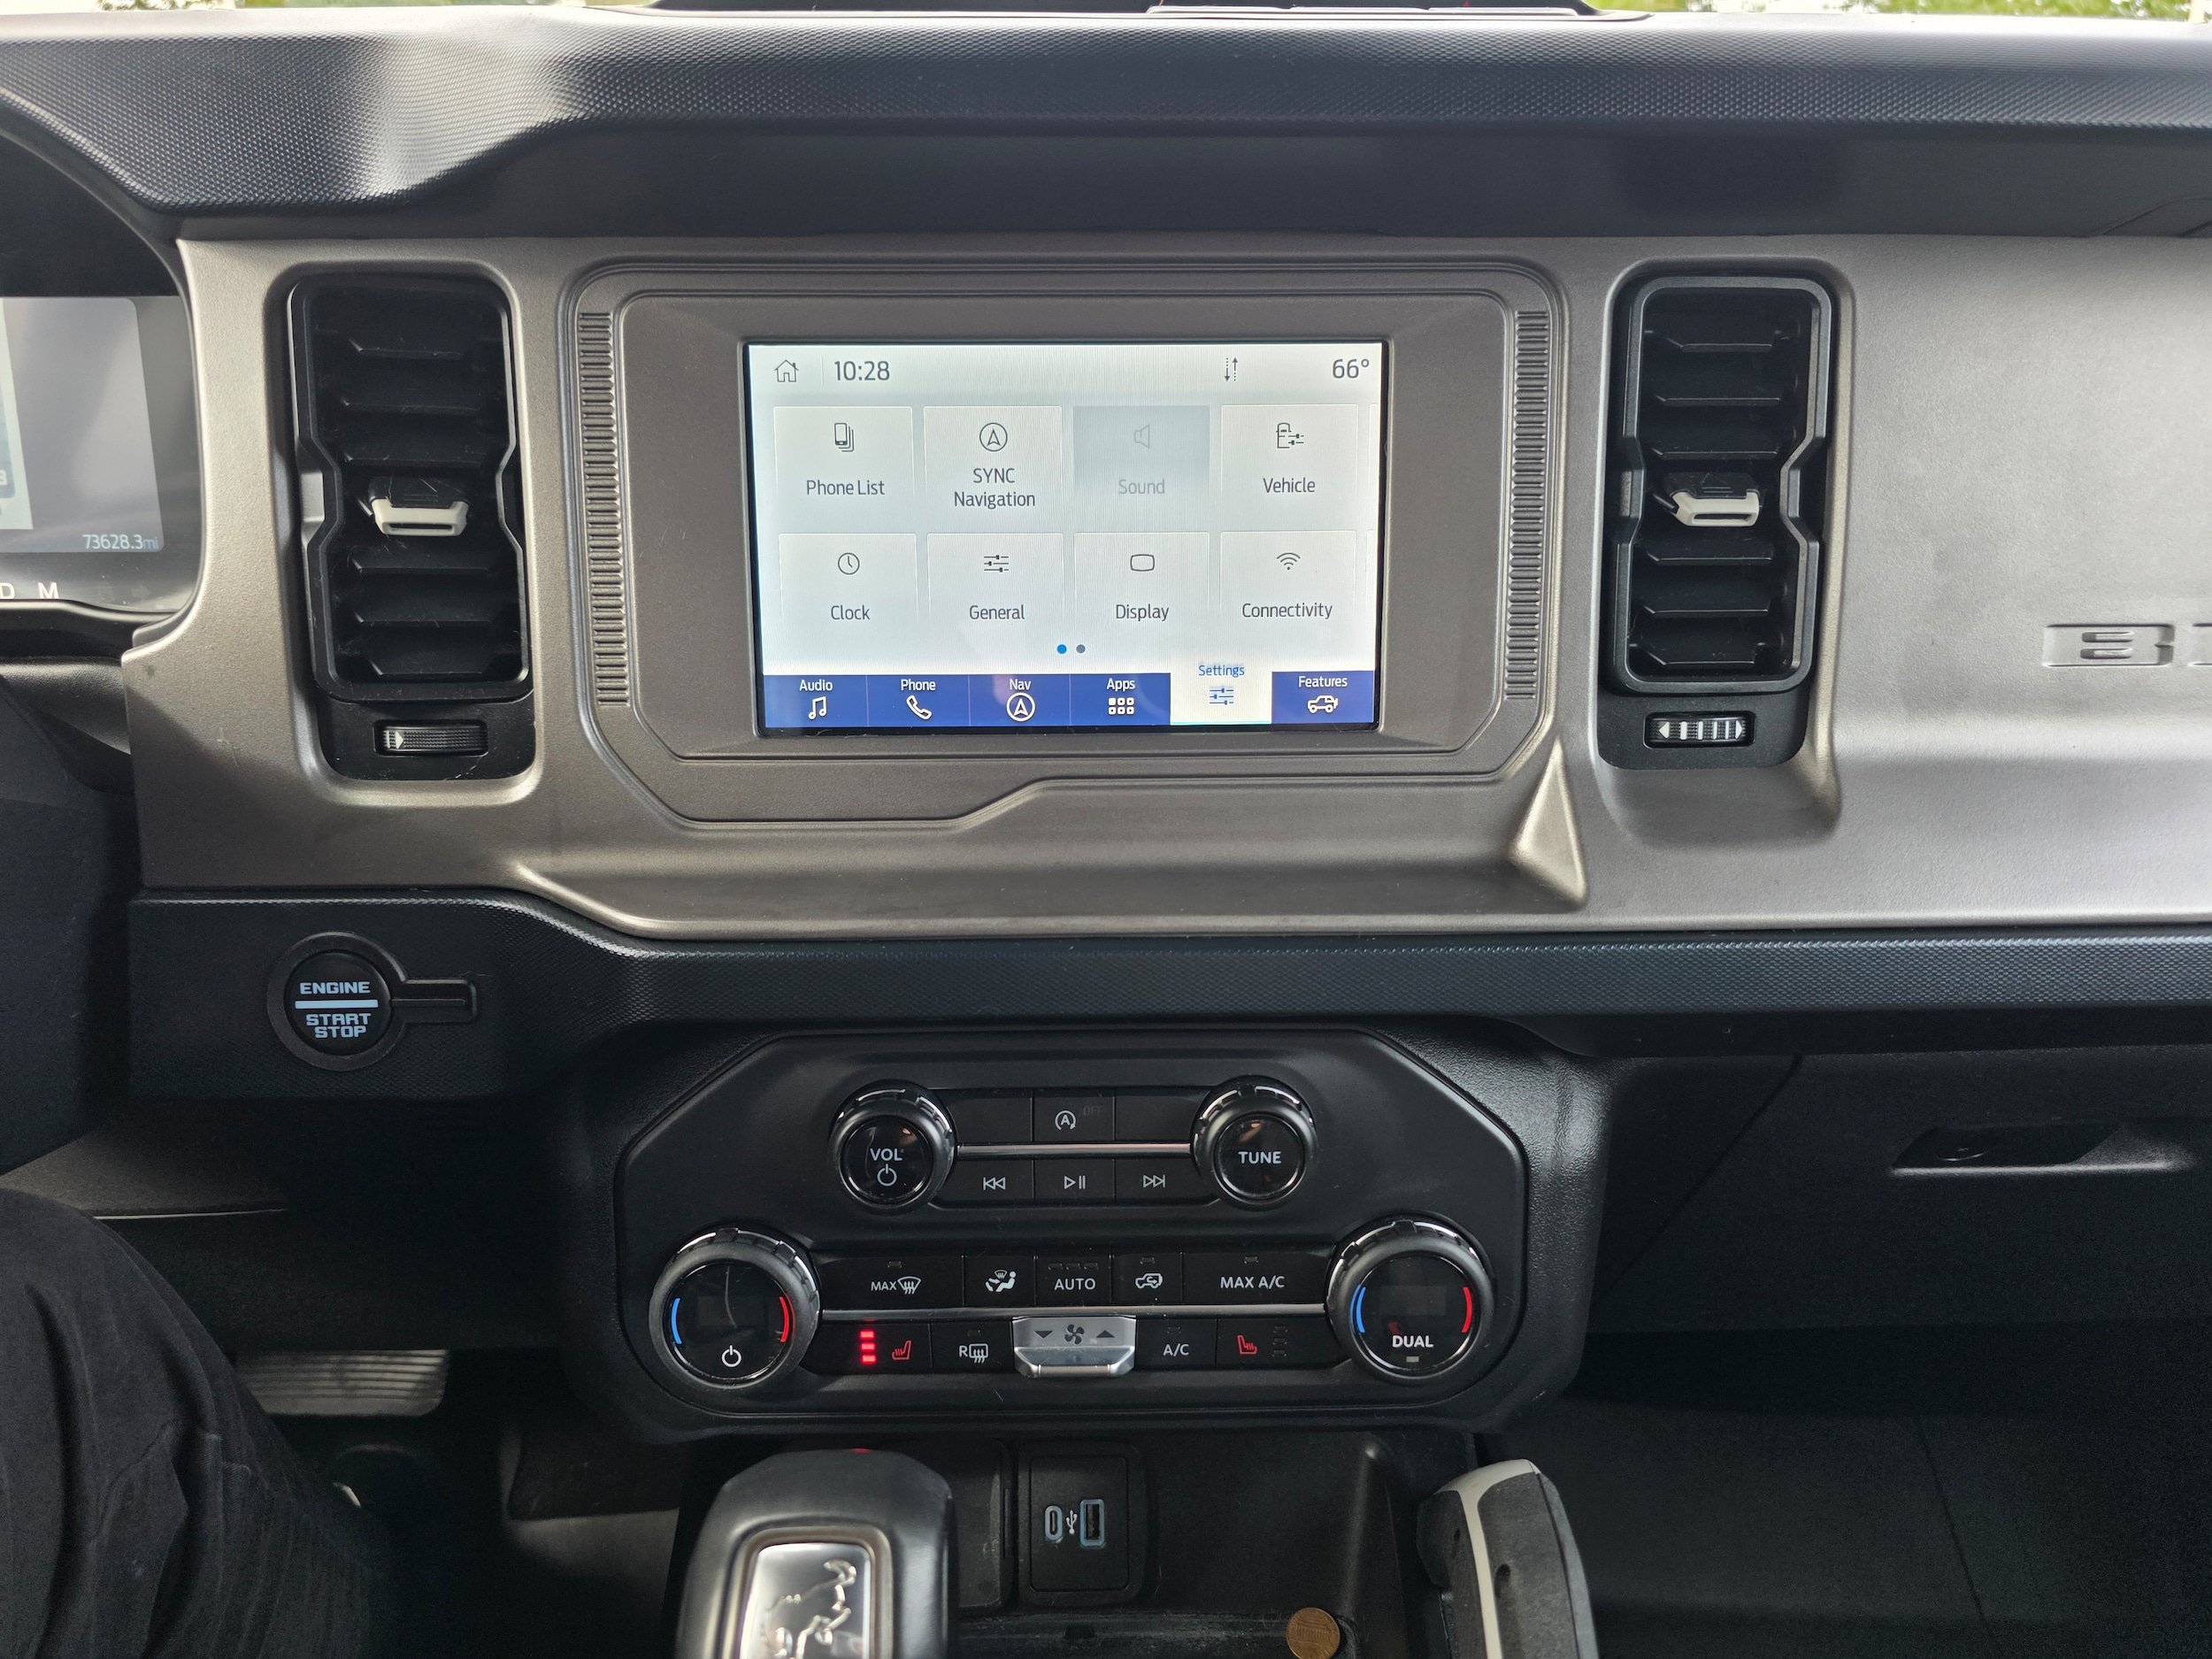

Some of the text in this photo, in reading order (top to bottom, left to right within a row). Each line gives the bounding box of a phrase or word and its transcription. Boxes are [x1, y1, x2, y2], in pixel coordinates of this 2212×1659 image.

[833, 360, 890, 381] 10:28
[1332, 358, 1371, 379] 66°
[972, 468, 1016, 484] SYNC
[806, 480, 886, 495] Phone List
[1118, 479, 1165, 495] Sound
[1263, 477, 1316, 494] Vehicle
[954, 491, 1036, 510] Navigation
[37, 581, 59, 600] M
[830, 605, 871, 621] Clock
[969, 604, 1025, 620] General
[1115, 603, 1170, 622] Display
[1241, 603, 1333, 620] Connectivity
[1198, 664, 1245, 678] Settings
[799, 679, 833, 692] Audio
[900, 679, 936, 692] Phone
[1009, 679, 1032, 691] Nav
[1106, 678, 1136, 692] Apps
[1298, 675, 1348, 688] Features
[299, 981, 371, 995] ENGINE
[305, 1012, 372, 1026] START
[314, 1025, 367, 1039] STOP
[870, 1148, 902, 1162] VOL
[1238, 1150, 1282, 1164] TUNE
[871, 1281, 897, 1292] MAX
[1054, 1278, 1096, 1291] AUTO
[1220, 1275, 1285, 1290] MAX A/C
[1392, 1334, 1434, 1348] DUAL
[959, 1346, 968, 1358] R
[1163, 1343, 1189, 1356] A/C
